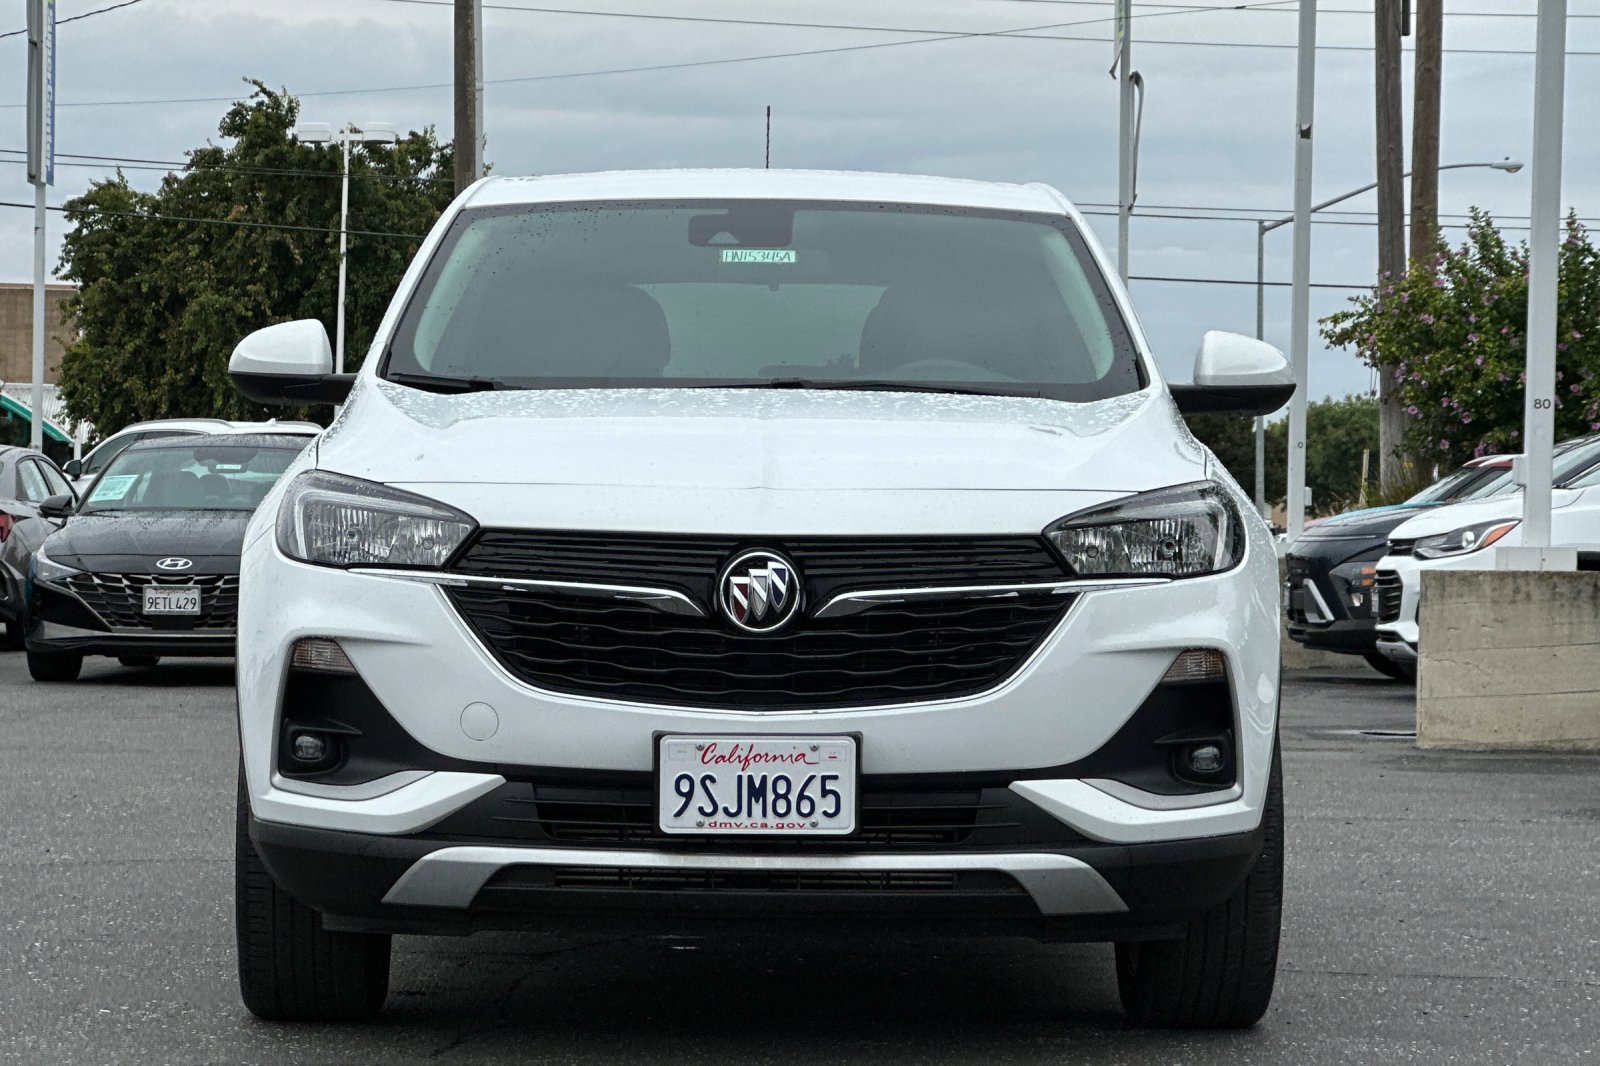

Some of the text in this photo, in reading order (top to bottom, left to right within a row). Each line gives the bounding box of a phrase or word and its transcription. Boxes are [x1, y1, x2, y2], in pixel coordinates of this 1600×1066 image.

[1533, 398, 1551, 409] 80
[147, 596, 197, 610] 9ETL429
[700, 742, 820, 772] California
[673, 773, 842, 818] 9SJM865
[708, 820, 806, 830] dmv.ca.gov
